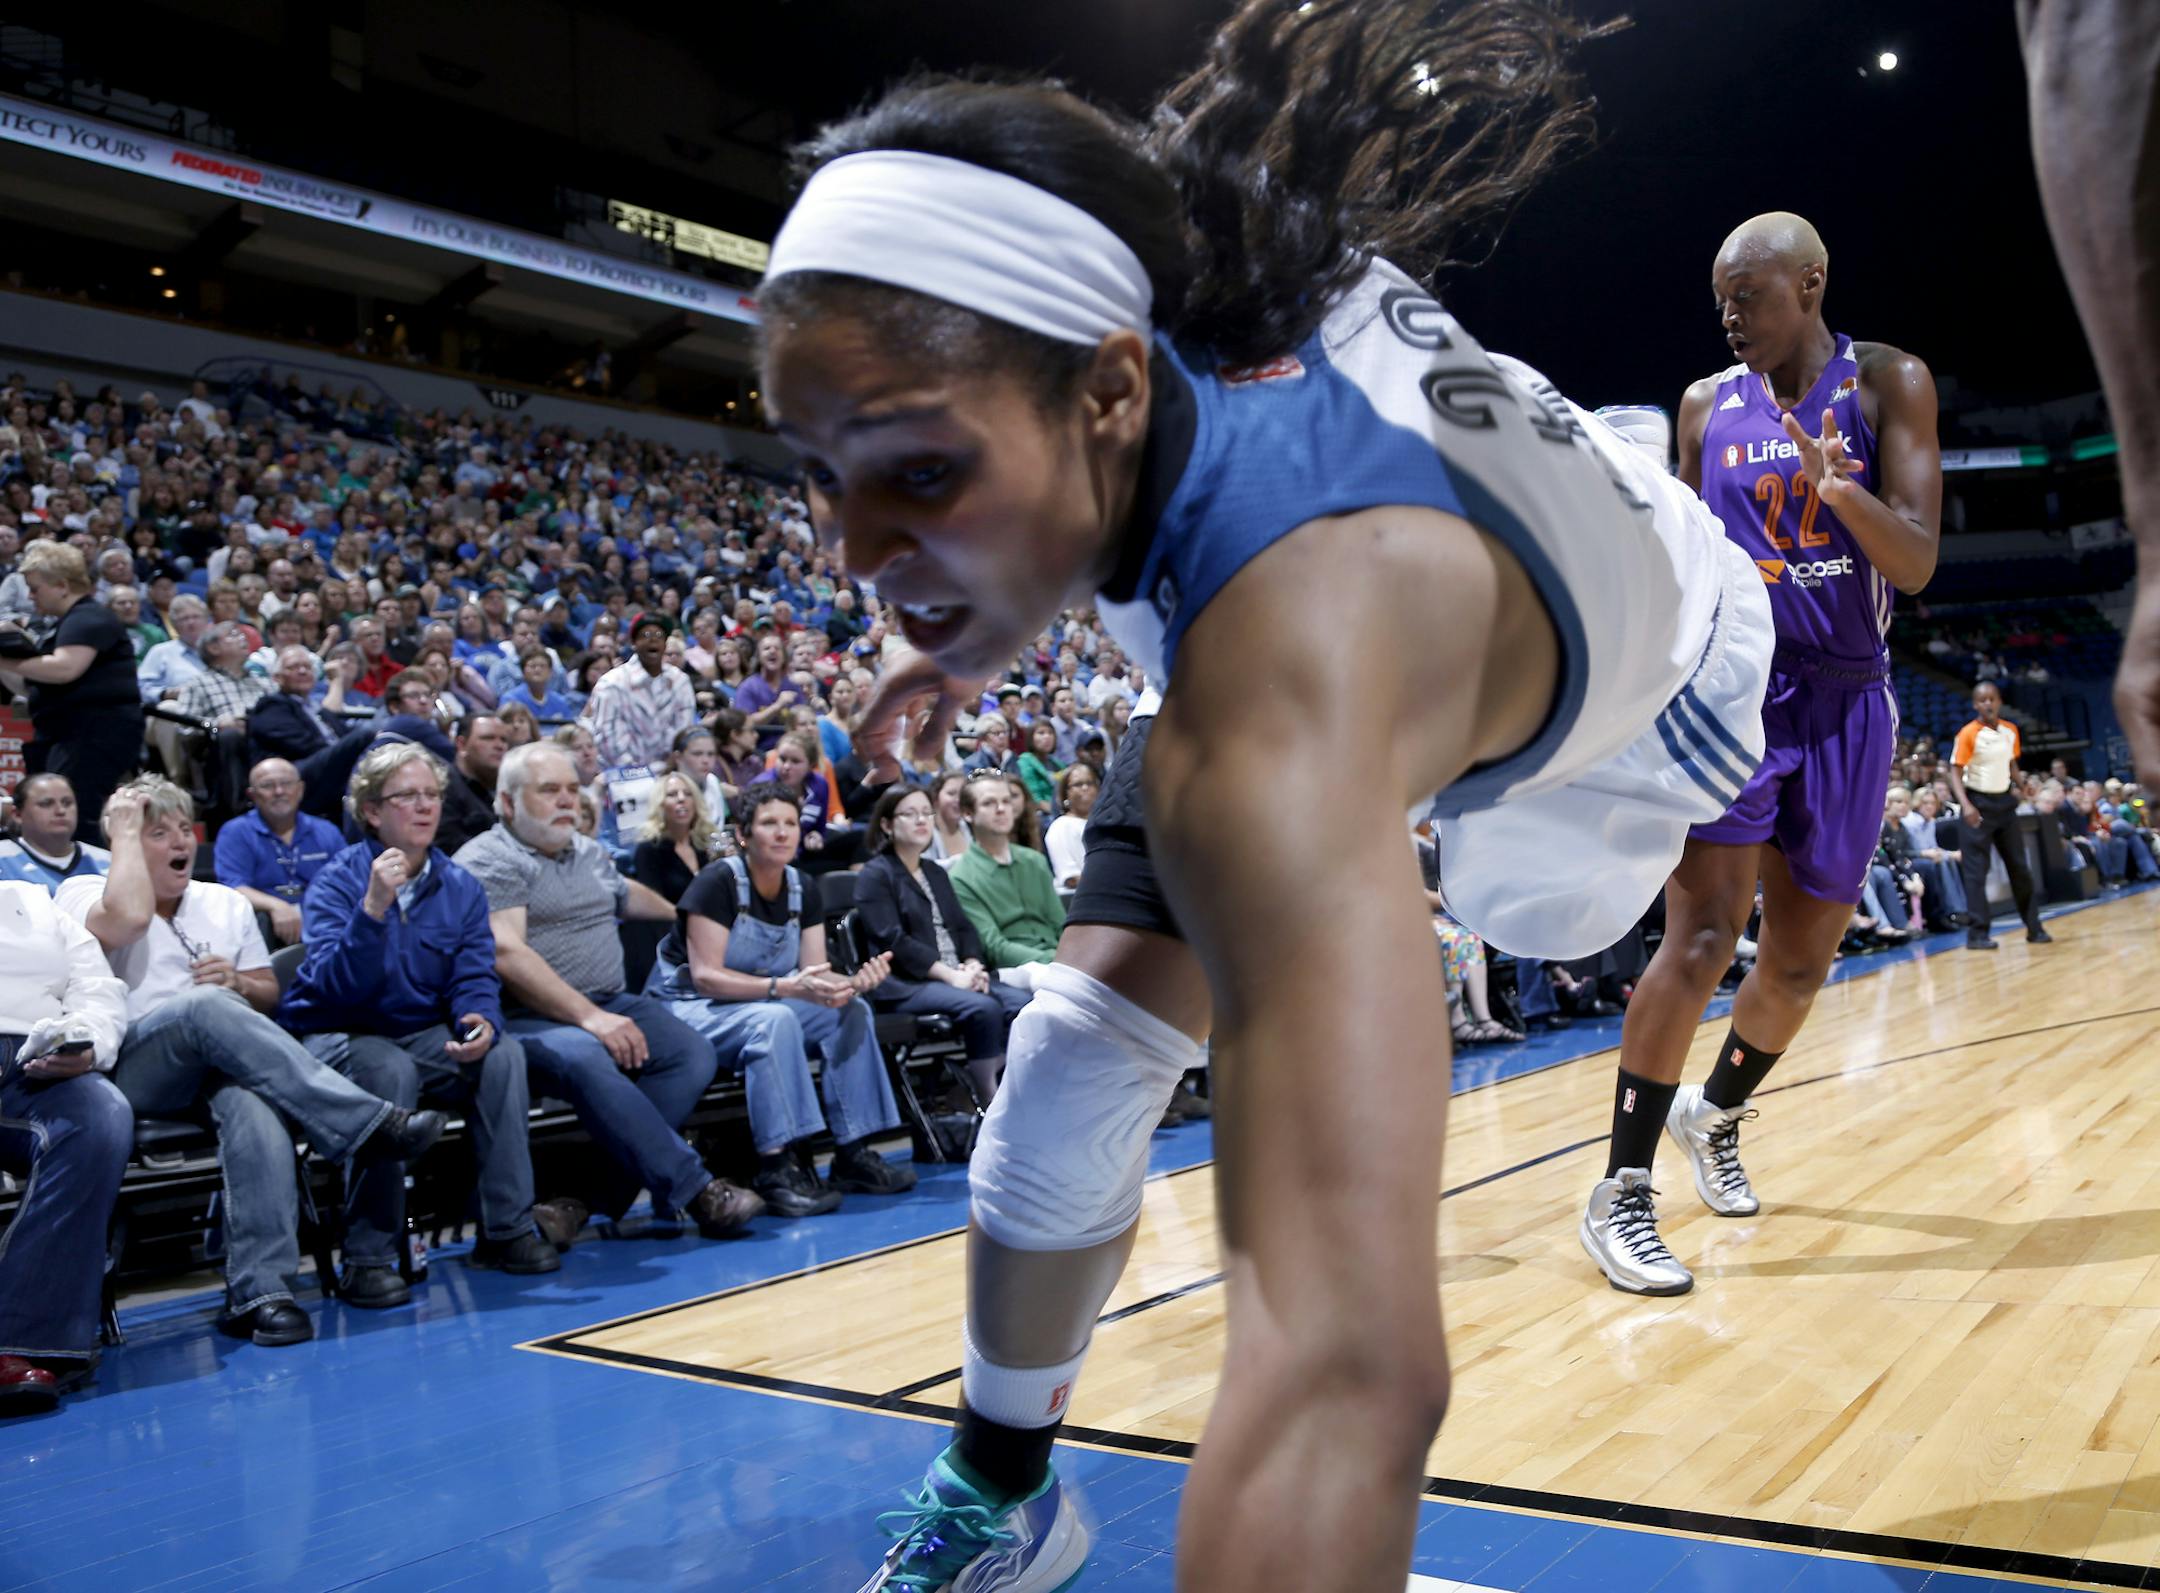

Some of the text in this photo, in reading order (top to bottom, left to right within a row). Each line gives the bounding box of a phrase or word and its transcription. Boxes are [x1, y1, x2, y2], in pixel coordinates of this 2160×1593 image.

[66, 124, 148, 163] YOURS
[171, 151, 263, 184] FEDERATED
[564, 255, 587, 273] TO
[1755, 473, 1831, 550] 22
